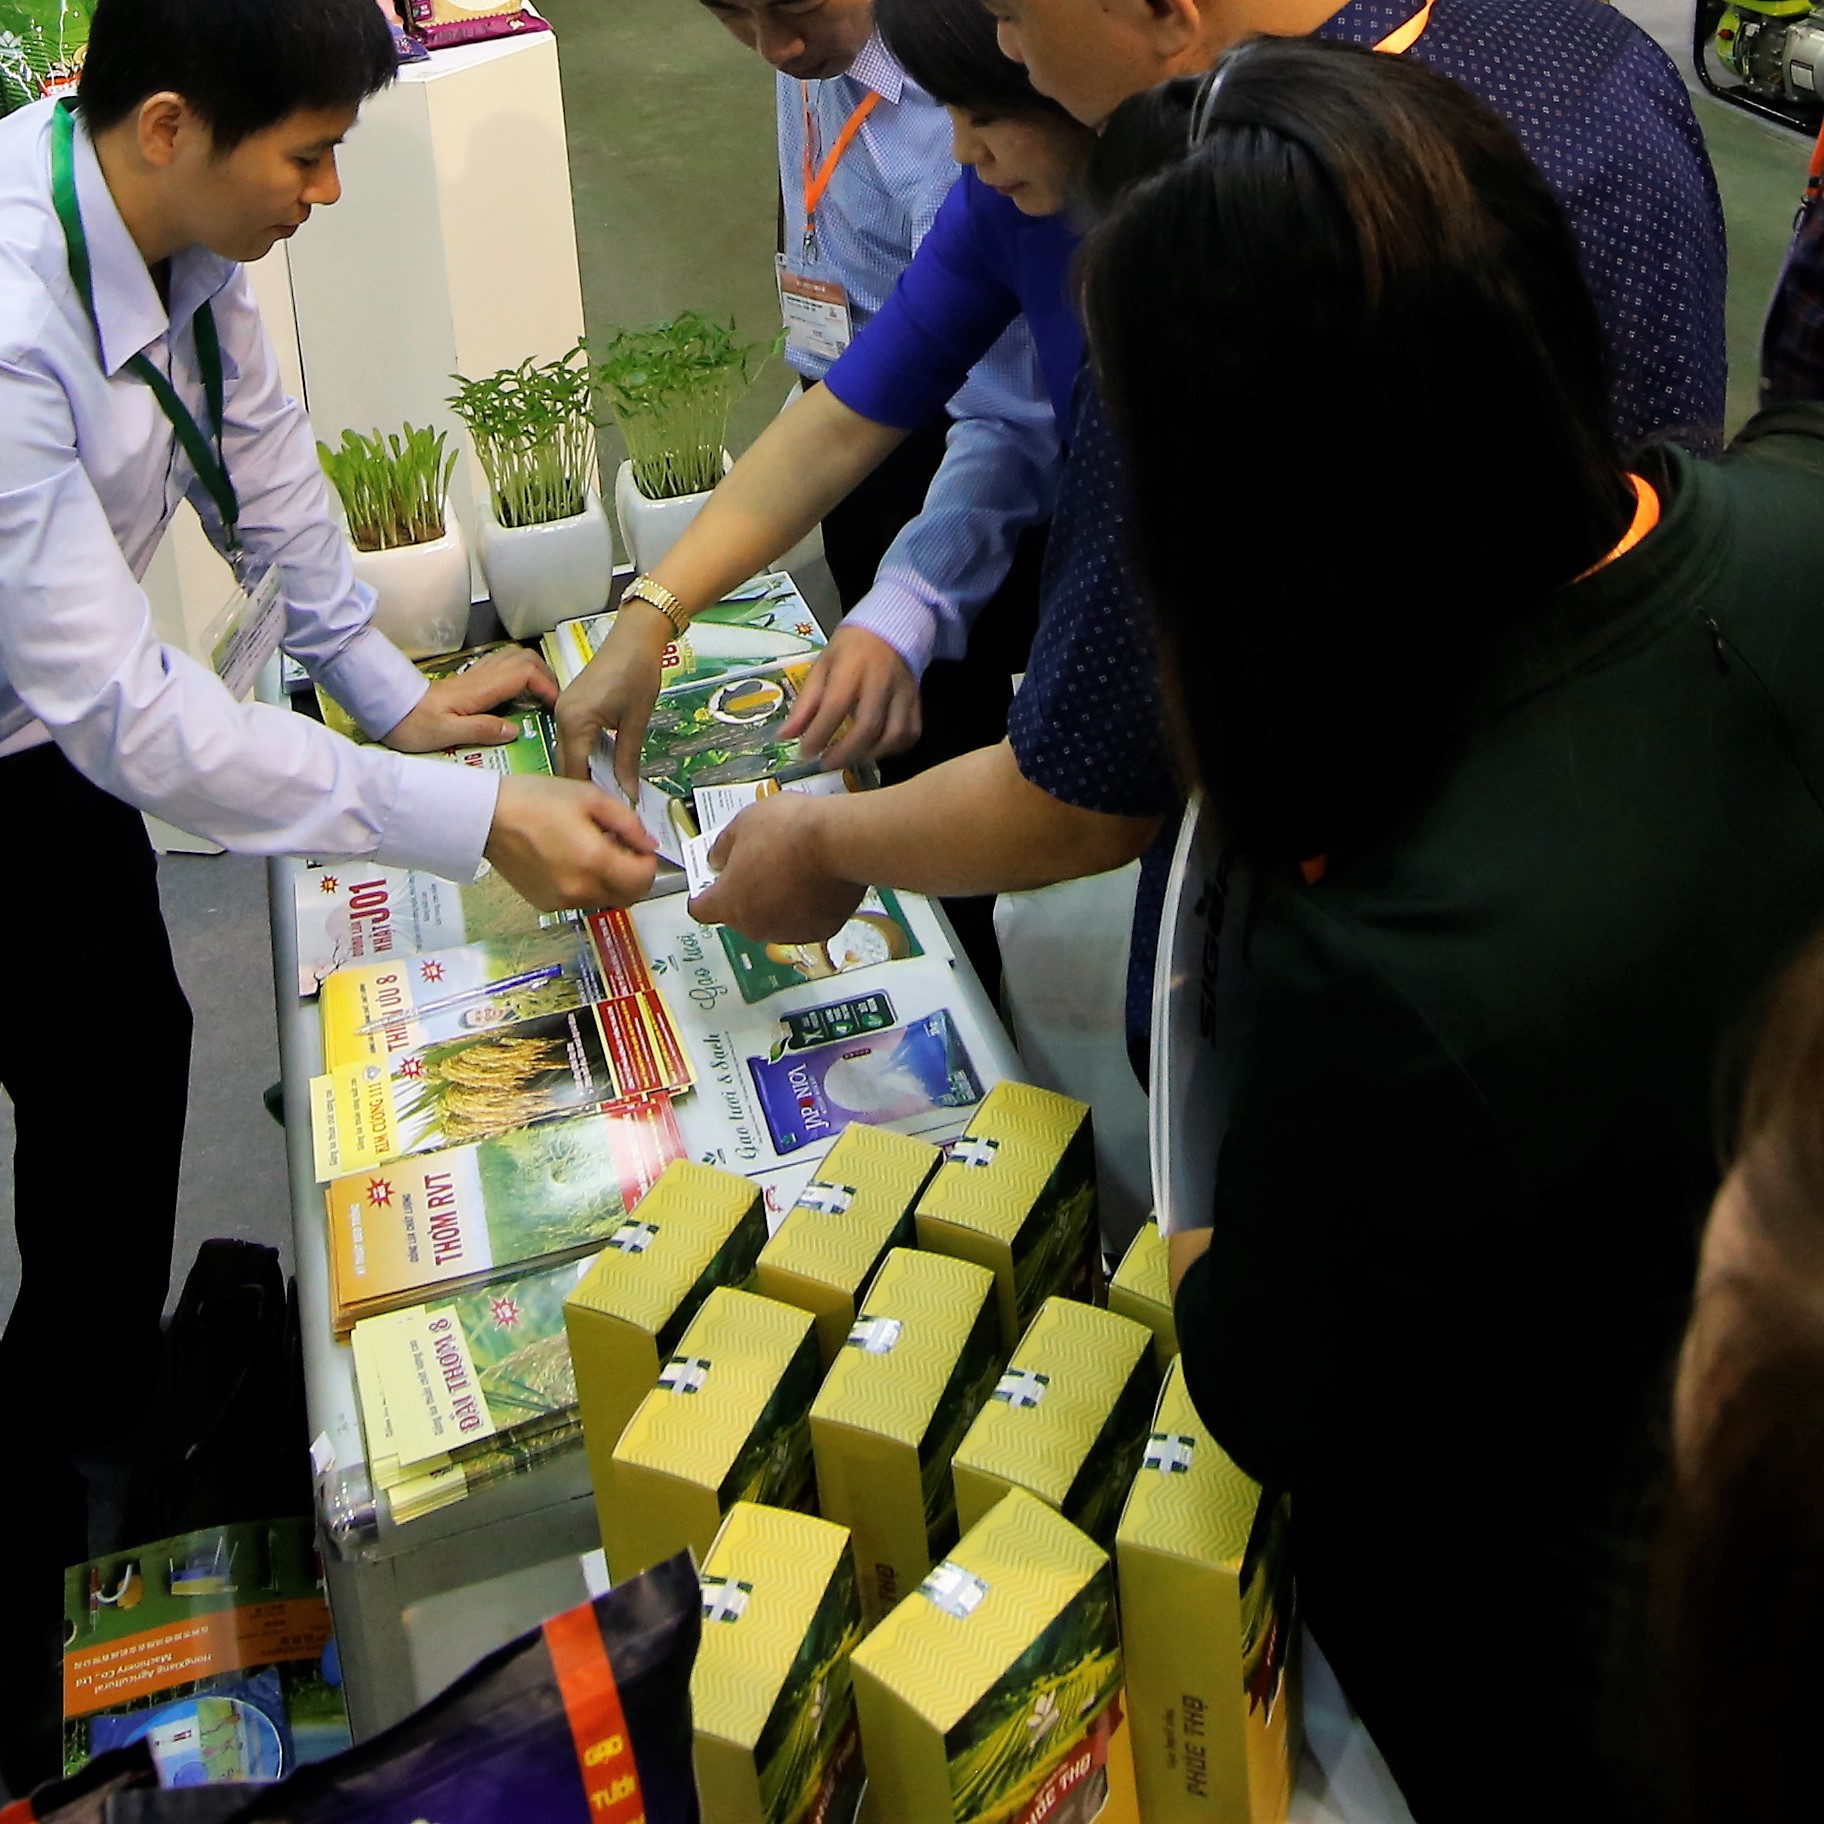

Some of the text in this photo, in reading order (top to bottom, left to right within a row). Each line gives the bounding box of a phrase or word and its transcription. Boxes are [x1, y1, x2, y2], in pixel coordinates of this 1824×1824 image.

[349, 878, 391, 923] J01
[676, 930, 704, 964] tươi
[375, 973, 398, 987] 8
[688, 966, 728, 1011] Gạo
[702, 1031, 729, 1072] Sạch
[721, 1091, 746, 1122] tươi
[733, 1126, 759, 1161] Gạo
[423, 1171, 465, 1267] THƠM RVT
[427, 1317, 451, 1333] 8
[75, 1674, 93, 1688] Ltd
